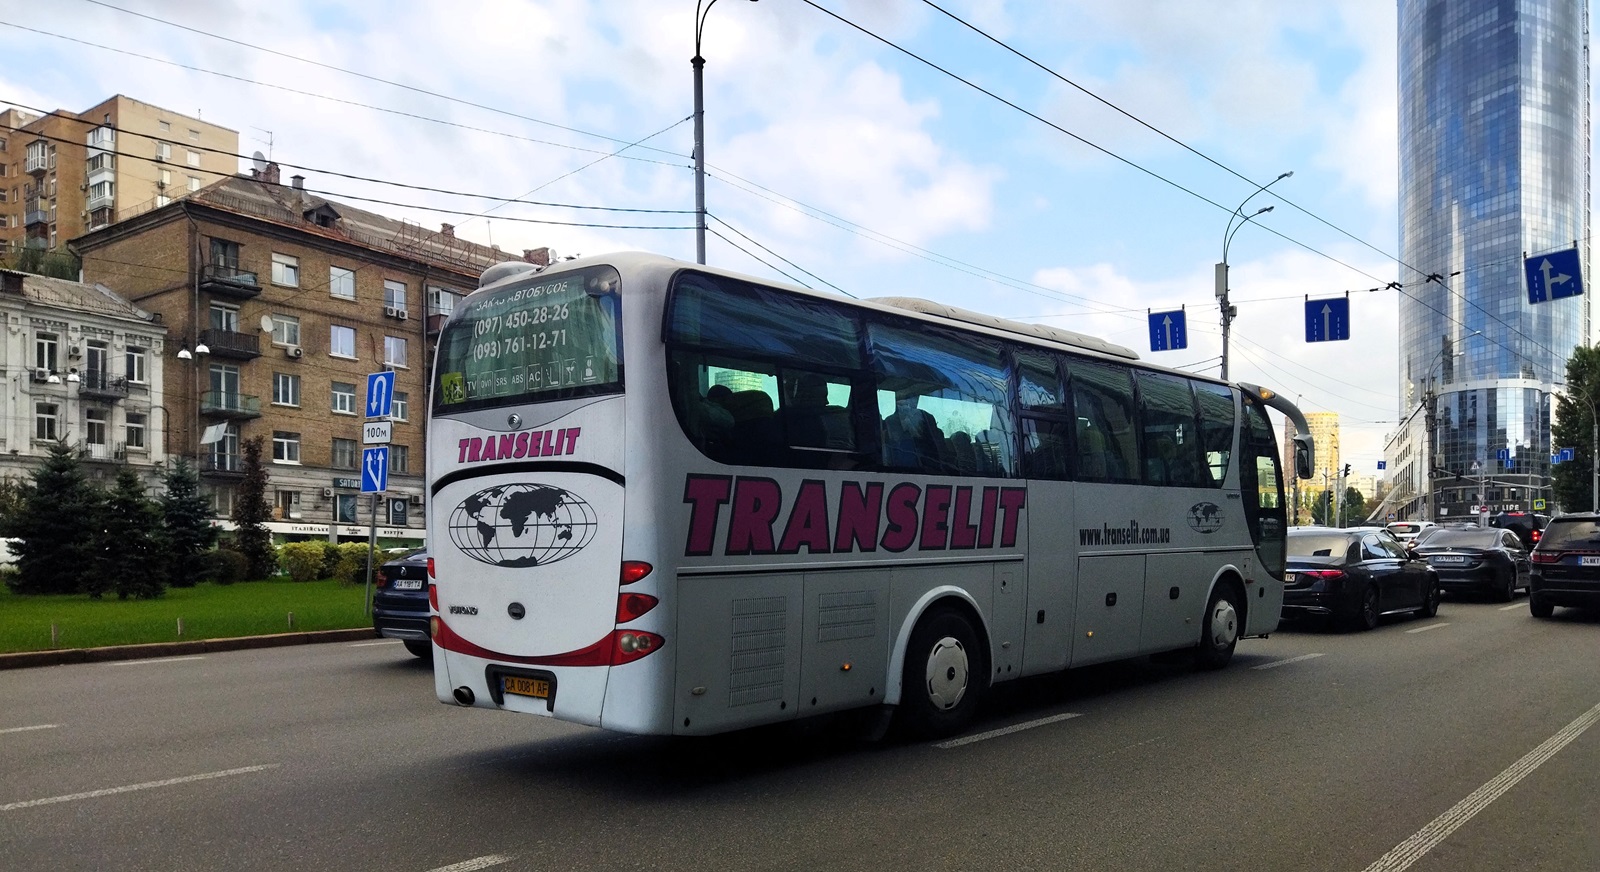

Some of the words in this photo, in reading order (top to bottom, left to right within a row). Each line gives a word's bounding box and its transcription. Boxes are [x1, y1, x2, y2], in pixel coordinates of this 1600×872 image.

[474, 316, 502, 338] (097)
[505, 303, 569, 329] 450-28-26
[473, 340, 501, 362] (093)
[505, 329, 566, 355] 761-12-71
[467, 380, 477, 392] TV
[495, 376, 507, 387] SRS
[511, 373, 524, 385] ABS
[528, 370, 541, 382] AC
[458, 427, 581, 463] TRANSELIT
[683, 473, 1027, 557] TRANSELIT
[1079, 519, 1170, 546] www.transelit.com.ua
[505, 678, 515, 690] CA
[517, 680, 535, 694] 0081
[537, 682, 548, 694] AF
